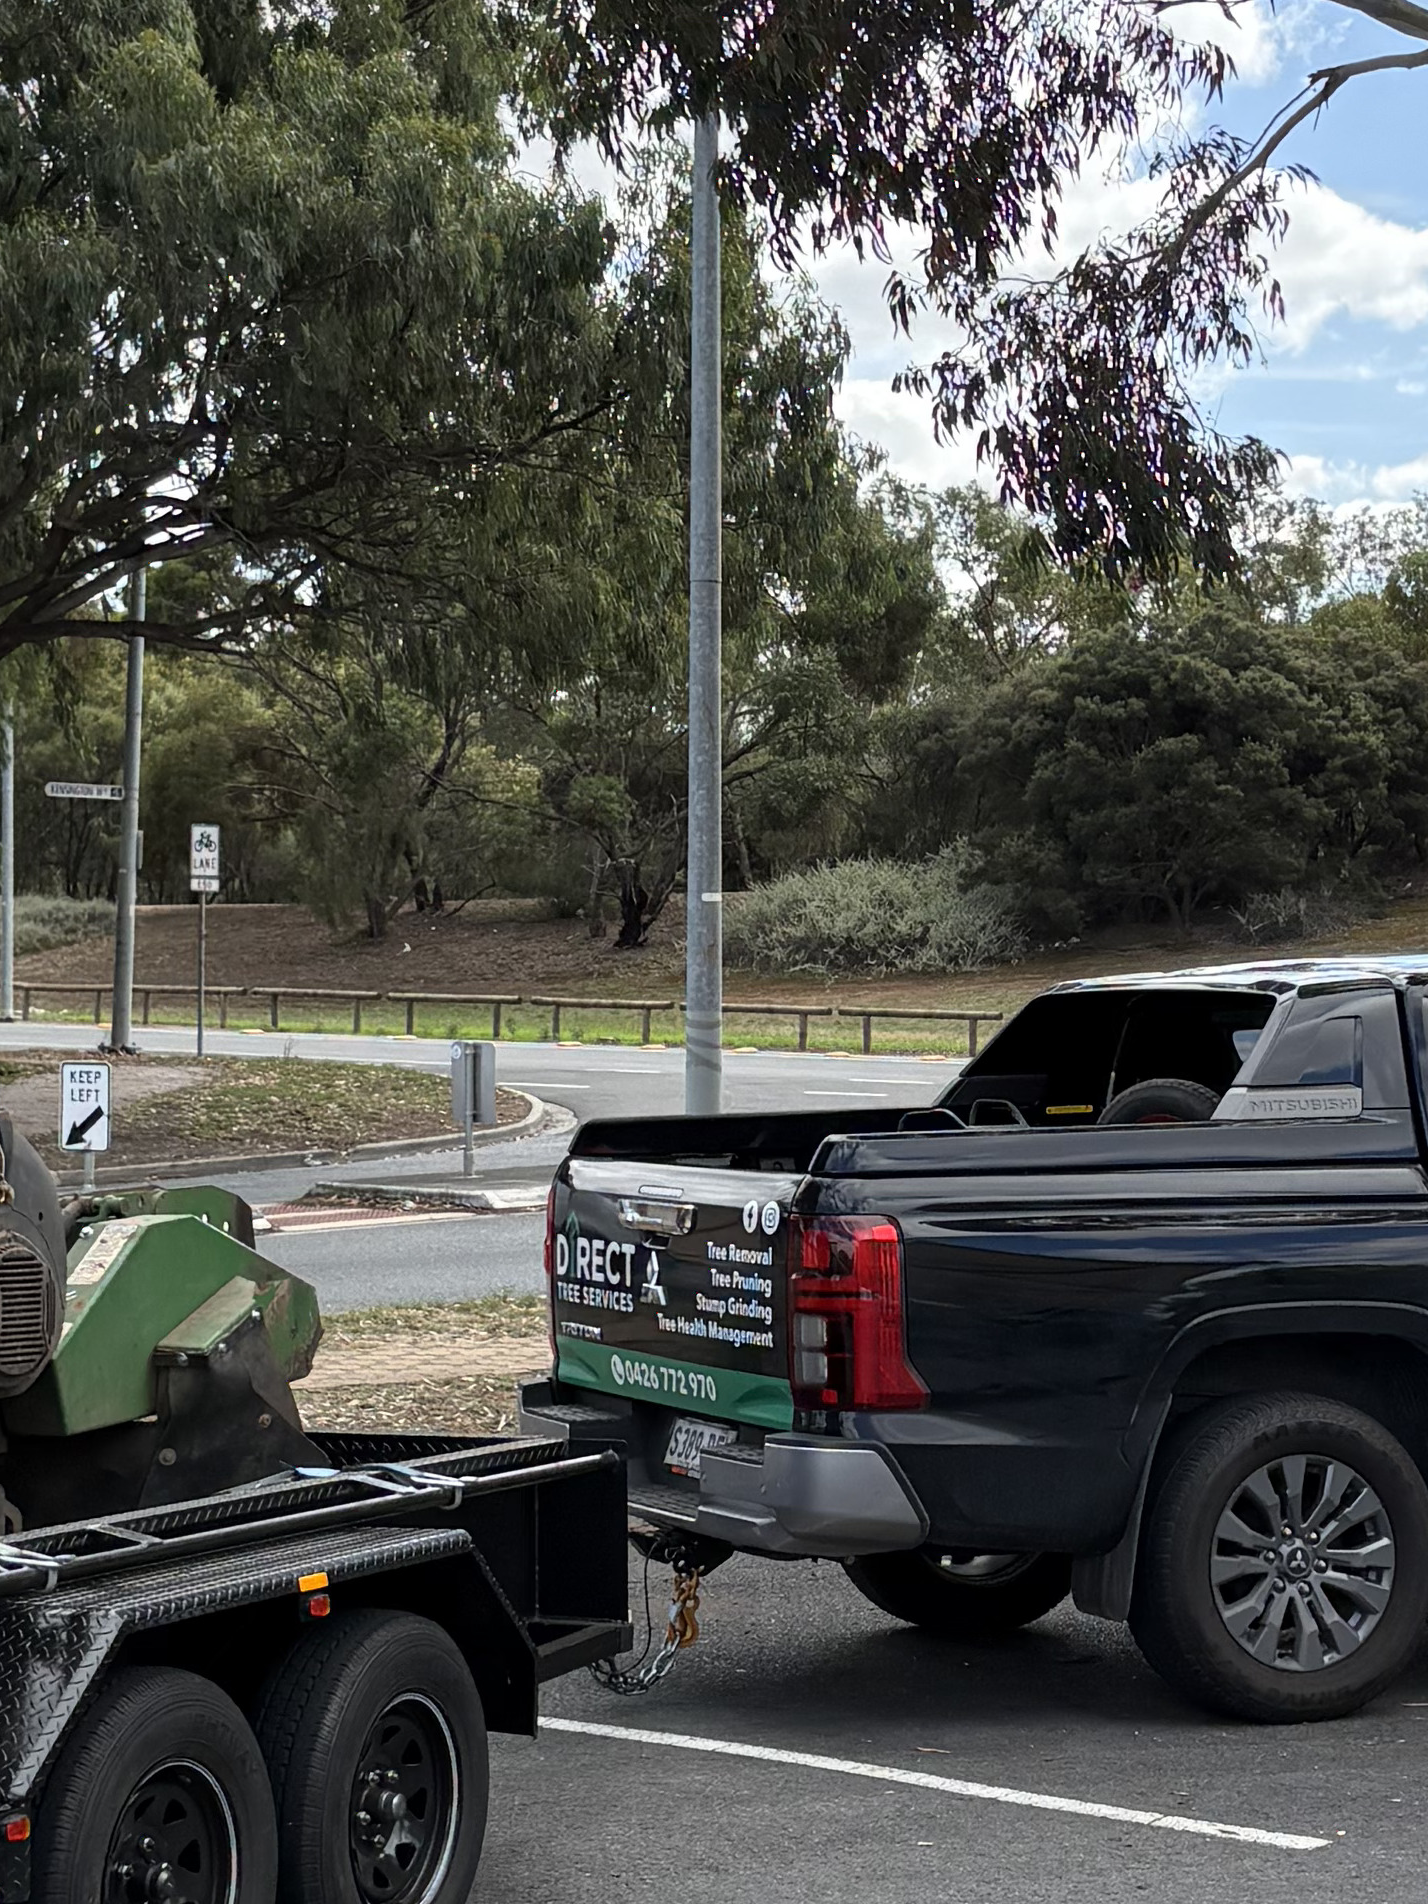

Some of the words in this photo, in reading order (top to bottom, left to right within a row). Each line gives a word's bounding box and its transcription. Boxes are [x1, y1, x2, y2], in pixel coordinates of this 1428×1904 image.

[194, 857, 217, 870] LANE
[70, 1070, 102, 1084] KEEP
[70, 1088, 101, 1103] LEFT
[1249, 1097, 1359, 1113] MITSUBISHI
[556, 1232, 636, 1288] DIRECT
[706, 1240, 728, 1261] Tree
[728, 1243, 772, 1266] Removal
[557, 1280, 581, 1304] TREE
[582, 1285, 634, 1313] SERVICES
[710, 1268, 731, 1288] Tree
[732, 1270, 772, 1298] Pruning
[695, 1292, 727, 1319] Stump
[727, 1296, 773, 1326] Grinding
[656, 1311, 677, 1332] Tree
[677, 1316, 707, 1339] Health
[707, 1319, 774, 1348] Management
[625, 1359, 660, 1391] 0426
[659, 1366, 689, 1396] 772
[688, 1372, 717, 1402] 970
